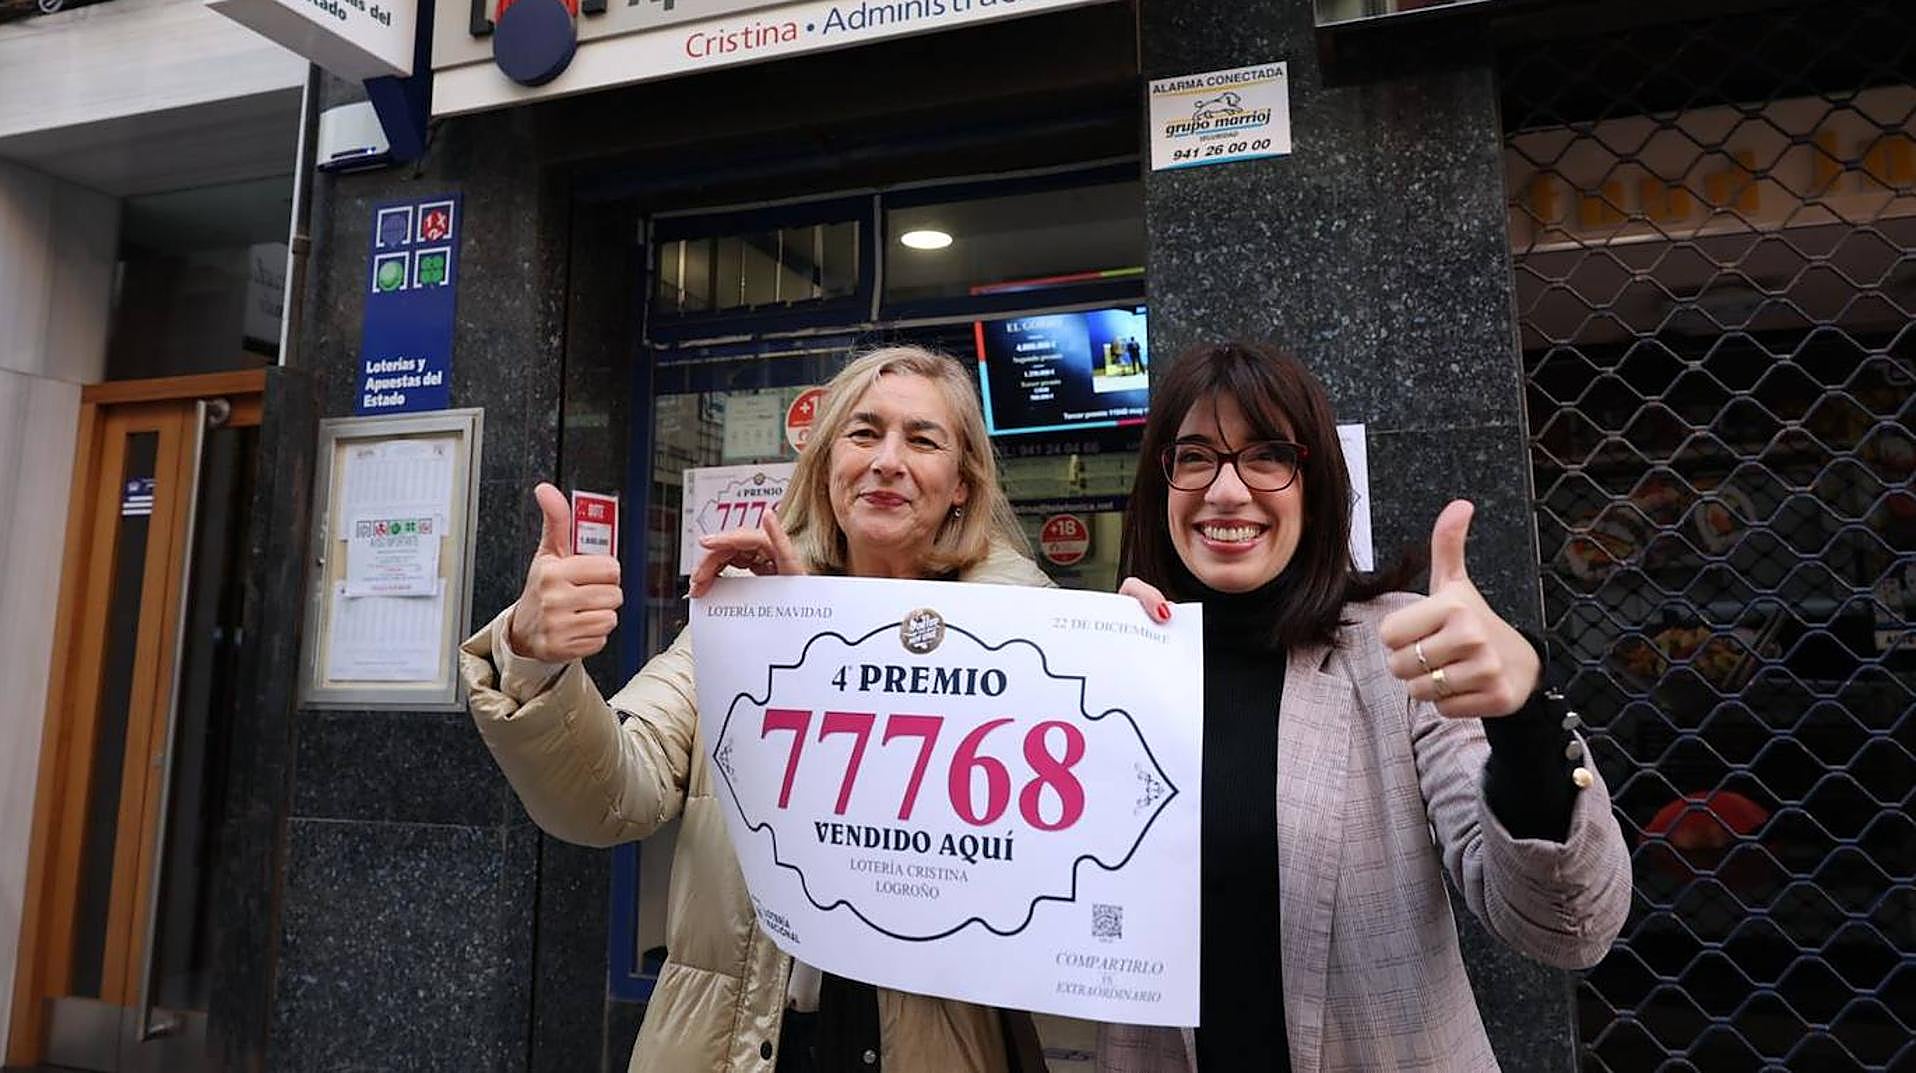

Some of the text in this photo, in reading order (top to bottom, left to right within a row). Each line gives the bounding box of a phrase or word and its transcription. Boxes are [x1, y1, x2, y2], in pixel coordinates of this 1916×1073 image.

[369, 4, 391, 27] del
[685, 22, 797, 59] Cristina
[1152, 67, 1283, 94] ALARMA CONECTADA
[1165, 120, 1210, 139] grupo
[1173, 138, 1272, 161] 941 26 00 00
[417, 358, 426, 373] y
[364, 369, 443, 393] Apuestas del
[363, 391, 406, 408] Estado
[744, 487, 783, 498] PREMIO
[1050, 520, 1077, 535] +18
[707, 605, 833, 619] LOTERÍA DE NAVIDAD
[1052, 616, 1067, 629] 22
[1070, 618, 1090, 632] DE
[858, 664, 1008, 697] PREMIO
[760, 708, 1086, 832] 77768
[814, 821, 1015, 865] VENDIDO AQUÍ
[849, 857, 969, 884] LOTERÍA CRISTINA
[875, 880, 940, 899] LOGROÑO
[1055, 952, 1165, 976] COMPARTIRLO
[1055, 980, 1163, 1003] EXTRAORDINARIO
